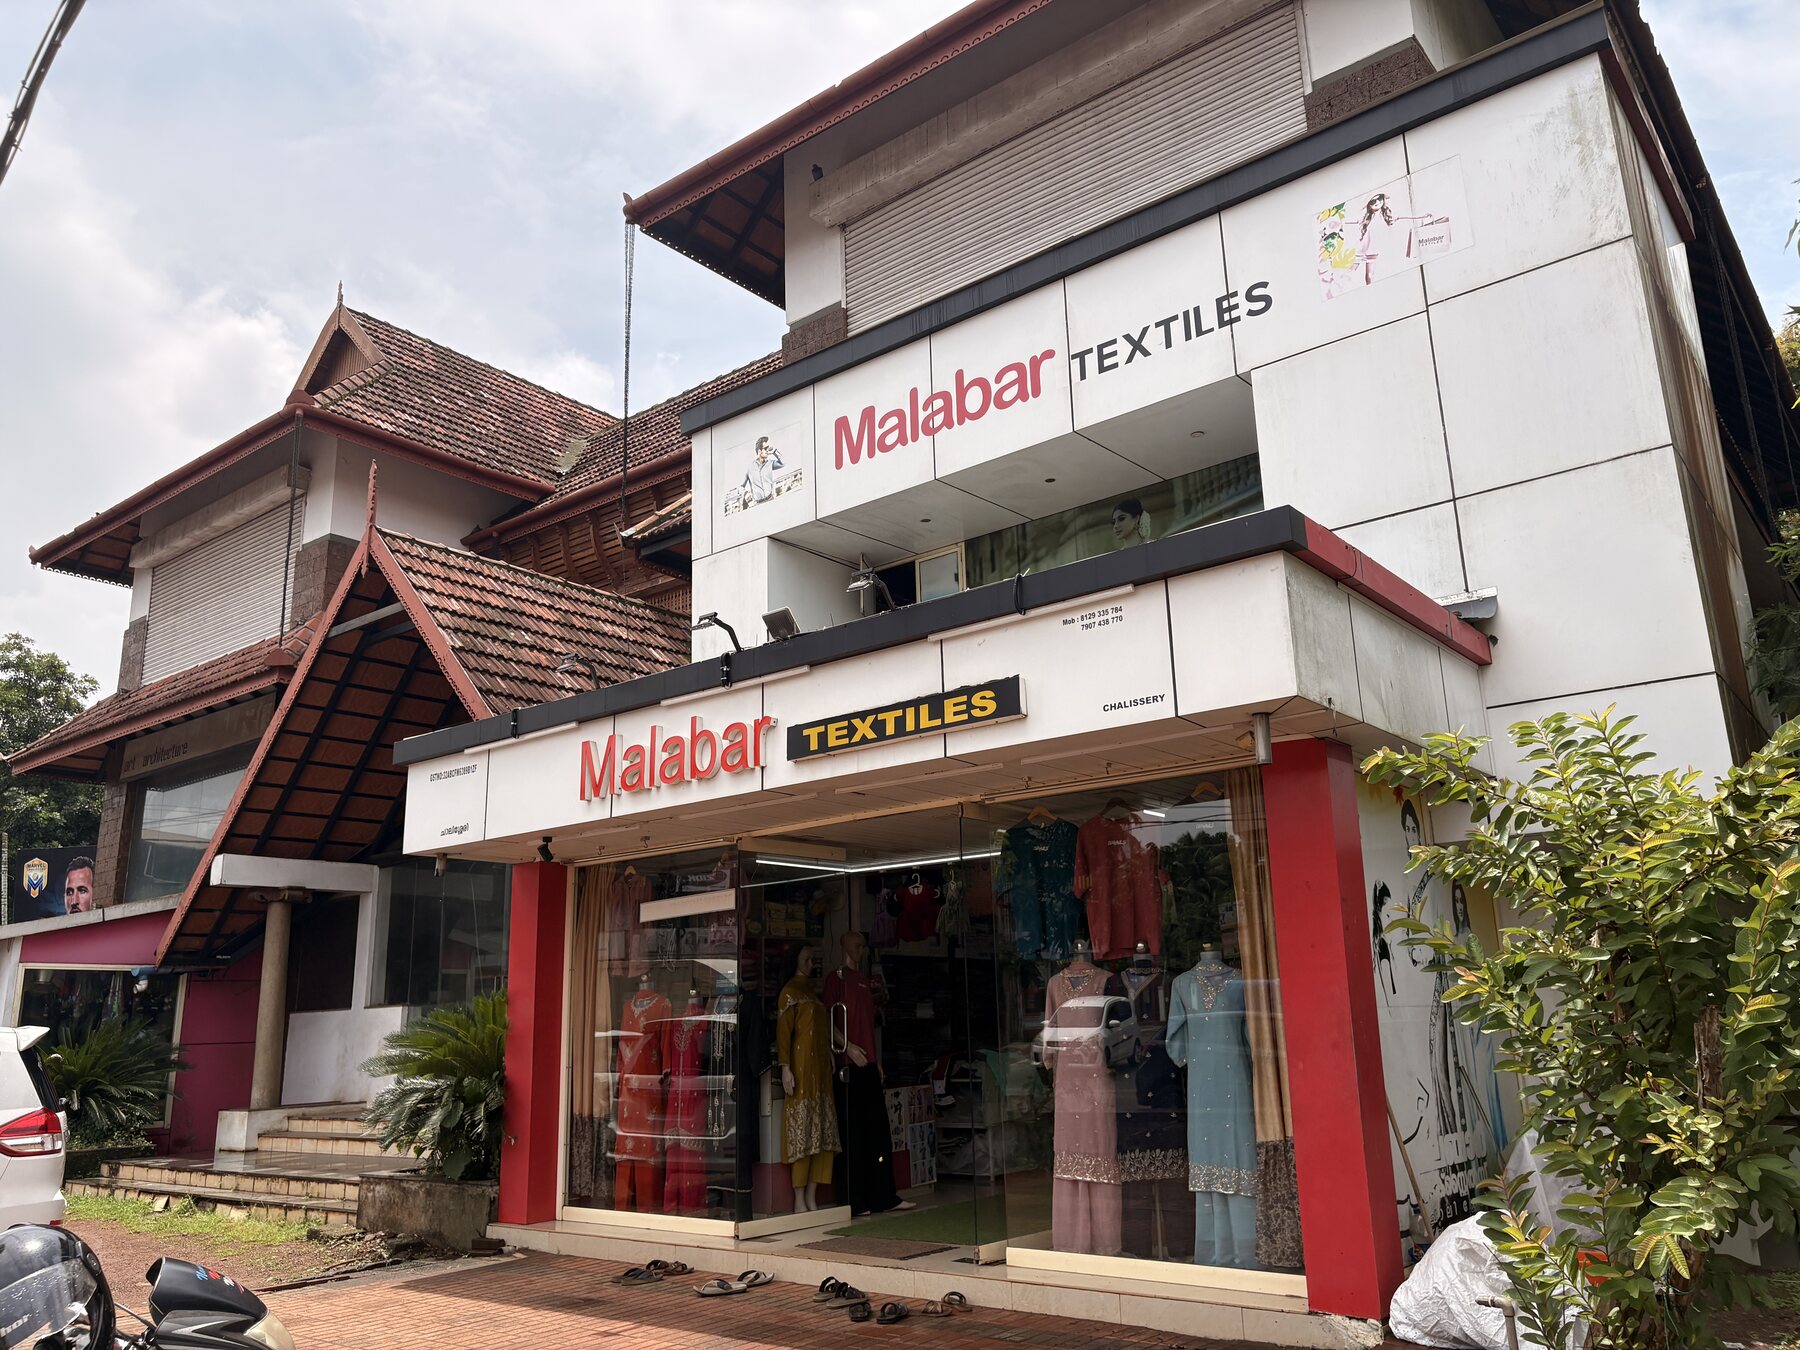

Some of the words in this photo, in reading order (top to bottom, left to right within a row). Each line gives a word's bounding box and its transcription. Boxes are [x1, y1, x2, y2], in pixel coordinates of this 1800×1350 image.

[1418, 235, 1444, 244] Malabar
[834, 348, 1056, 470] Malabar
[1070, 281, 1274, 382] TEXTILES
[1062, 617, 1076, 626] Mob
[1080, 612, 1096, 622] 8129
[1097, 609, 1109, 618] 335
[1110, 606, 1123, 615] 784
[1081, 621, 1096, 631] 7907
[1098, 618, 1110, 628] 438
[1111, 615, 1123, 624] 770
[1102, 694, 1166, 712] CHALISSERY
[142, 742, 188, 767] architecture
[580, 715, 777, 801] Malabar
[803, 690, 997, 751] TEXTILES
